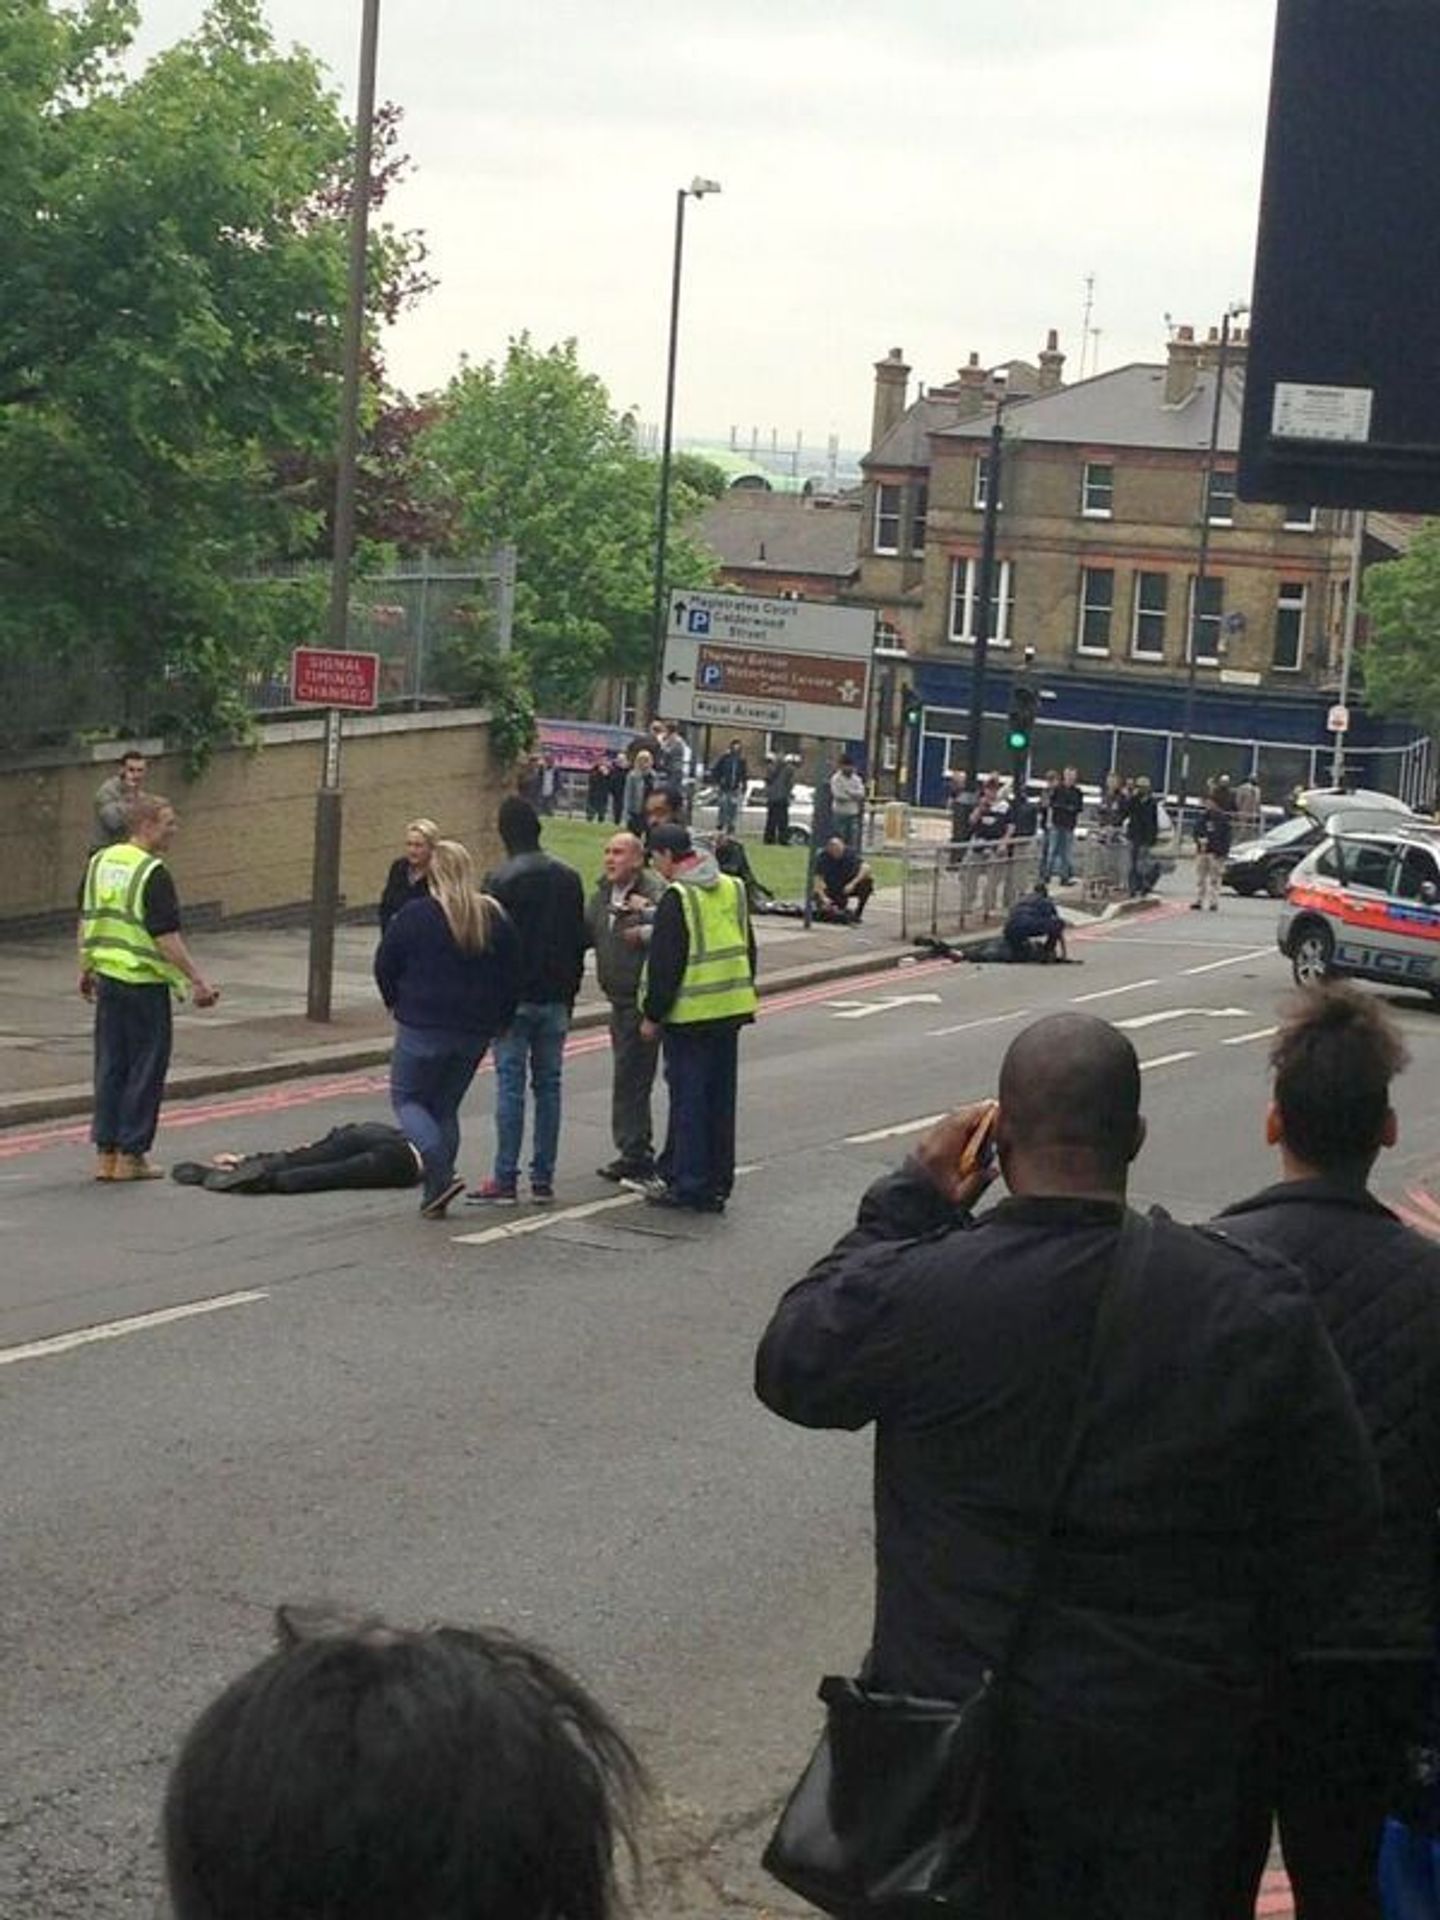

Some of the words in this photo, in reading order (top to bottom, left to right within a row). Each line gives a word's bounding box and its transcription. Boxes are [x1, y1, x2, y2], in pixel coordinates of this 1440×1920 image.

[763, 602, 798, 616] Court
[729, 626, 767, 640] Street
[309, 656, 361, 671] SIGNAL
[304, 670, 366, 687] TIMINGS
[298, 684, 370, 702] CHANGED
[697, 700, 731, 716] Royal
[735, 703, 779, 720] Arsenal
